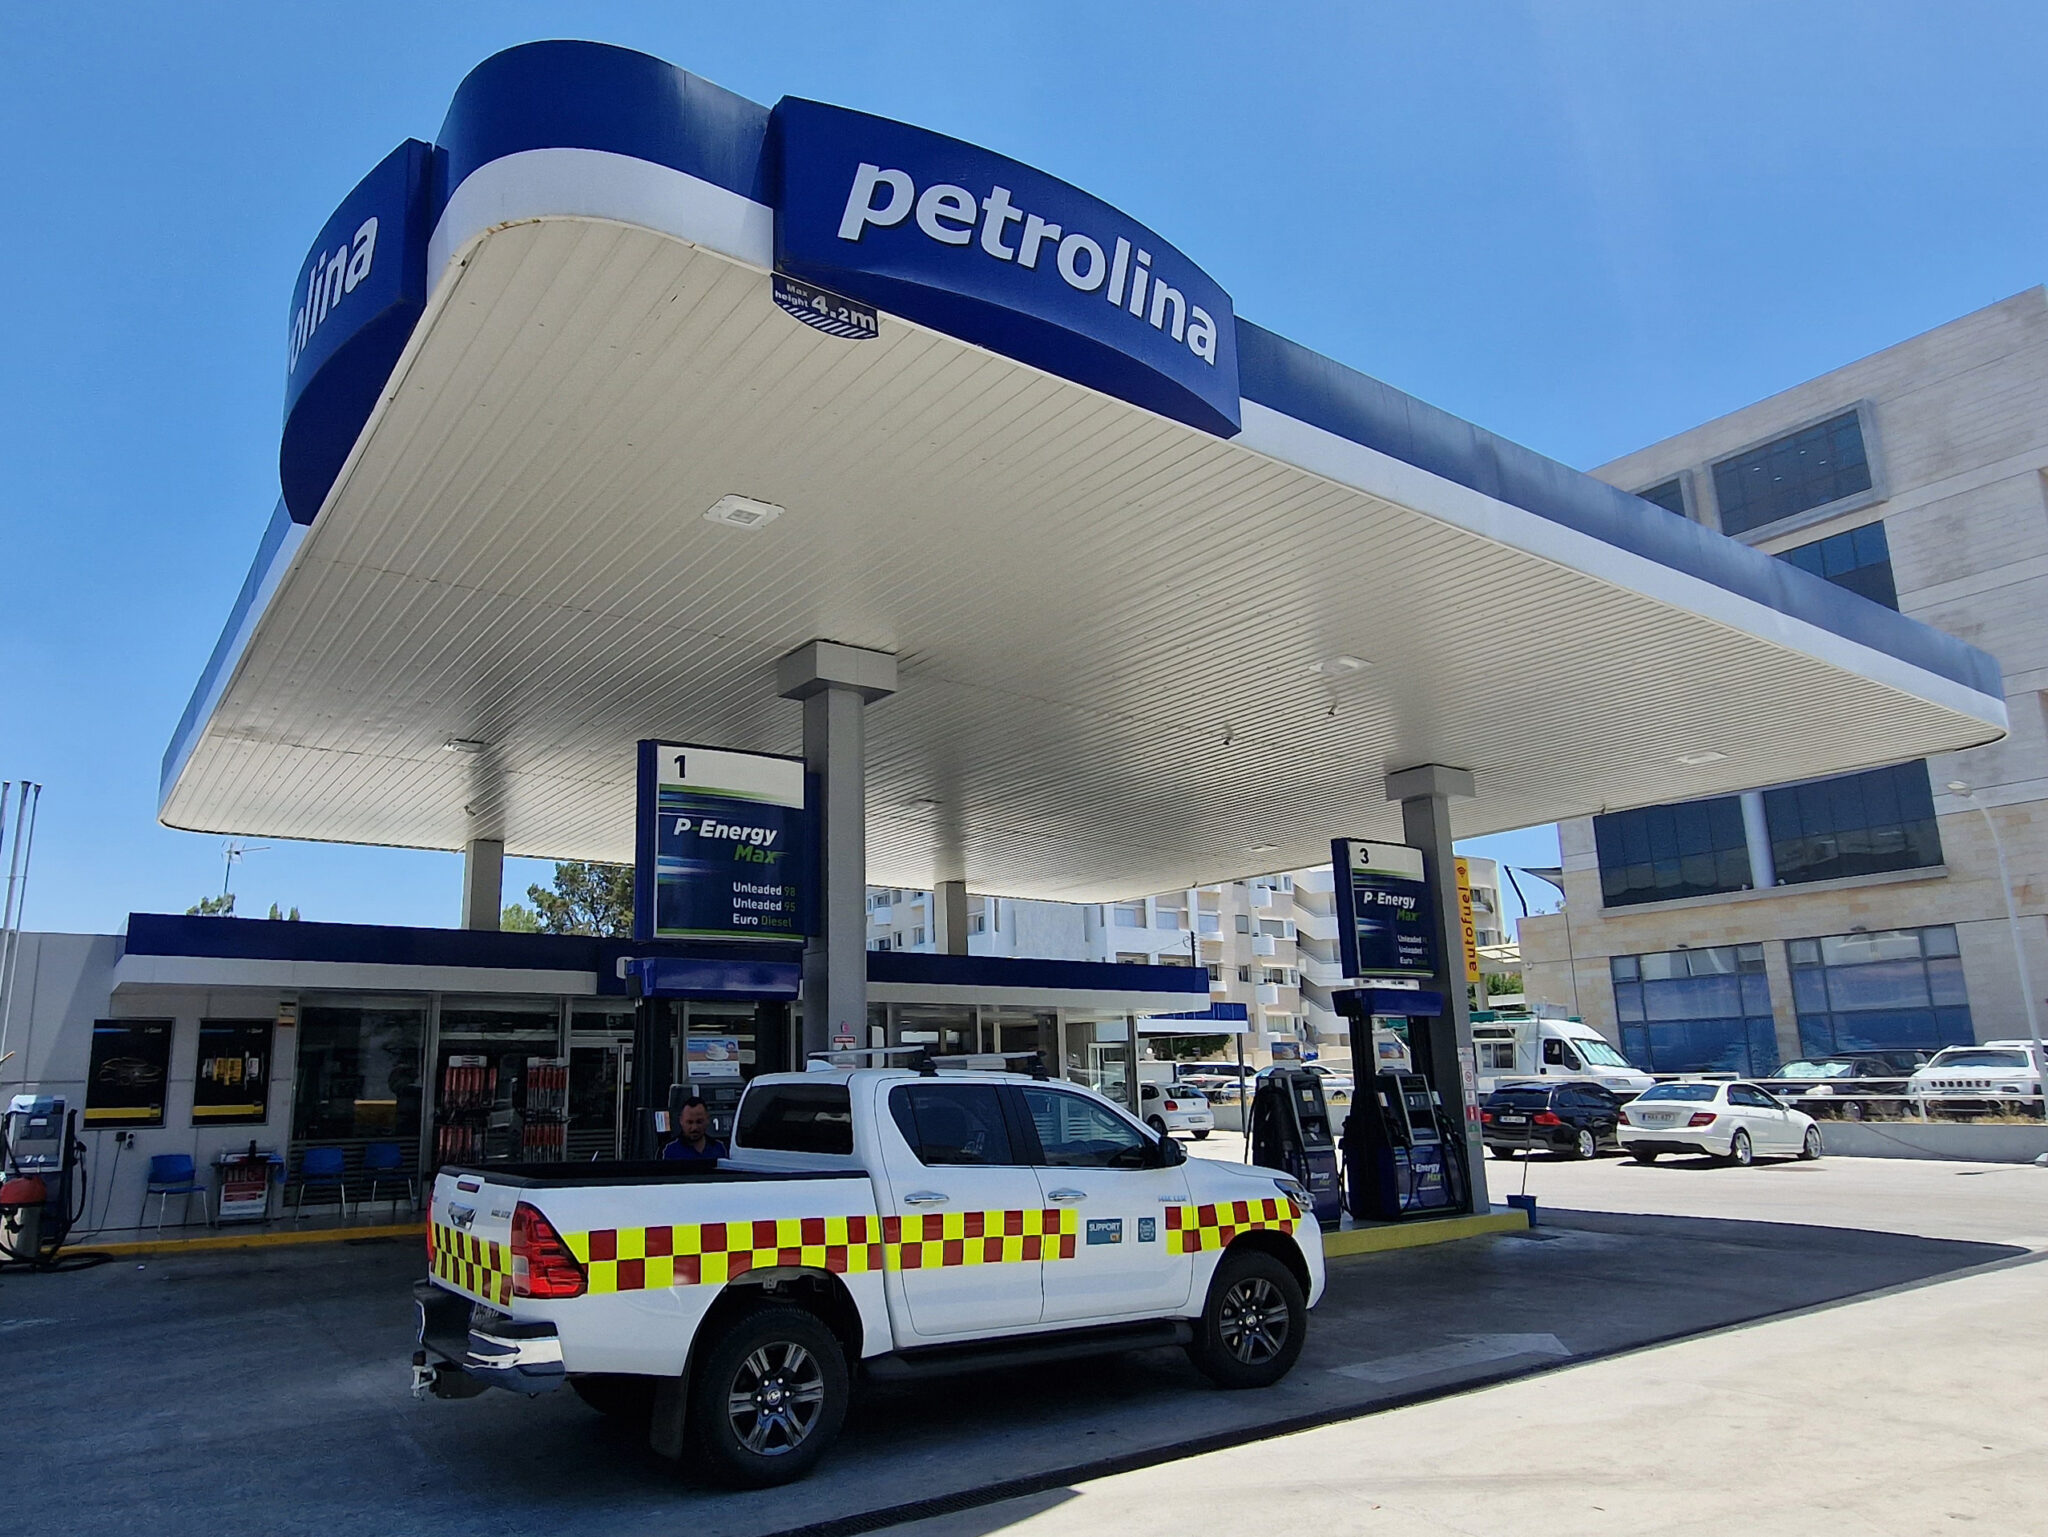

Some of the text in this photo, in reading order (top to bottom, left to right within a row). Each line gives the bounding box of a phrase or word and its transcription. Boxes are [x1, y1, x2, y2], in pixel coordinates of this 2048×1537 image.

[837, 161, 1218, 366] petrolina
[289, 216, 378, 375] olina
[786, 284, 808, 297] Max
[775, 290, 876, 331] height 4.2m
[674, 755, 686, 778] 1
[673, 818, 777, 846] P-Energy
[734, 844, 778, 864] Max
[1360, 848, 1369, 864] 3
[733, 881, 796, 897] Unleaded 98
[733, 897, 796, 912] Unleaded 95
[733, 913, 792, 928] Euro Diesel
[1396, 908, 1417, 921] Max
[1458, 887, 1477, 972] autofuel
[1088, 1222, 1121, 1232] SUPPORT
